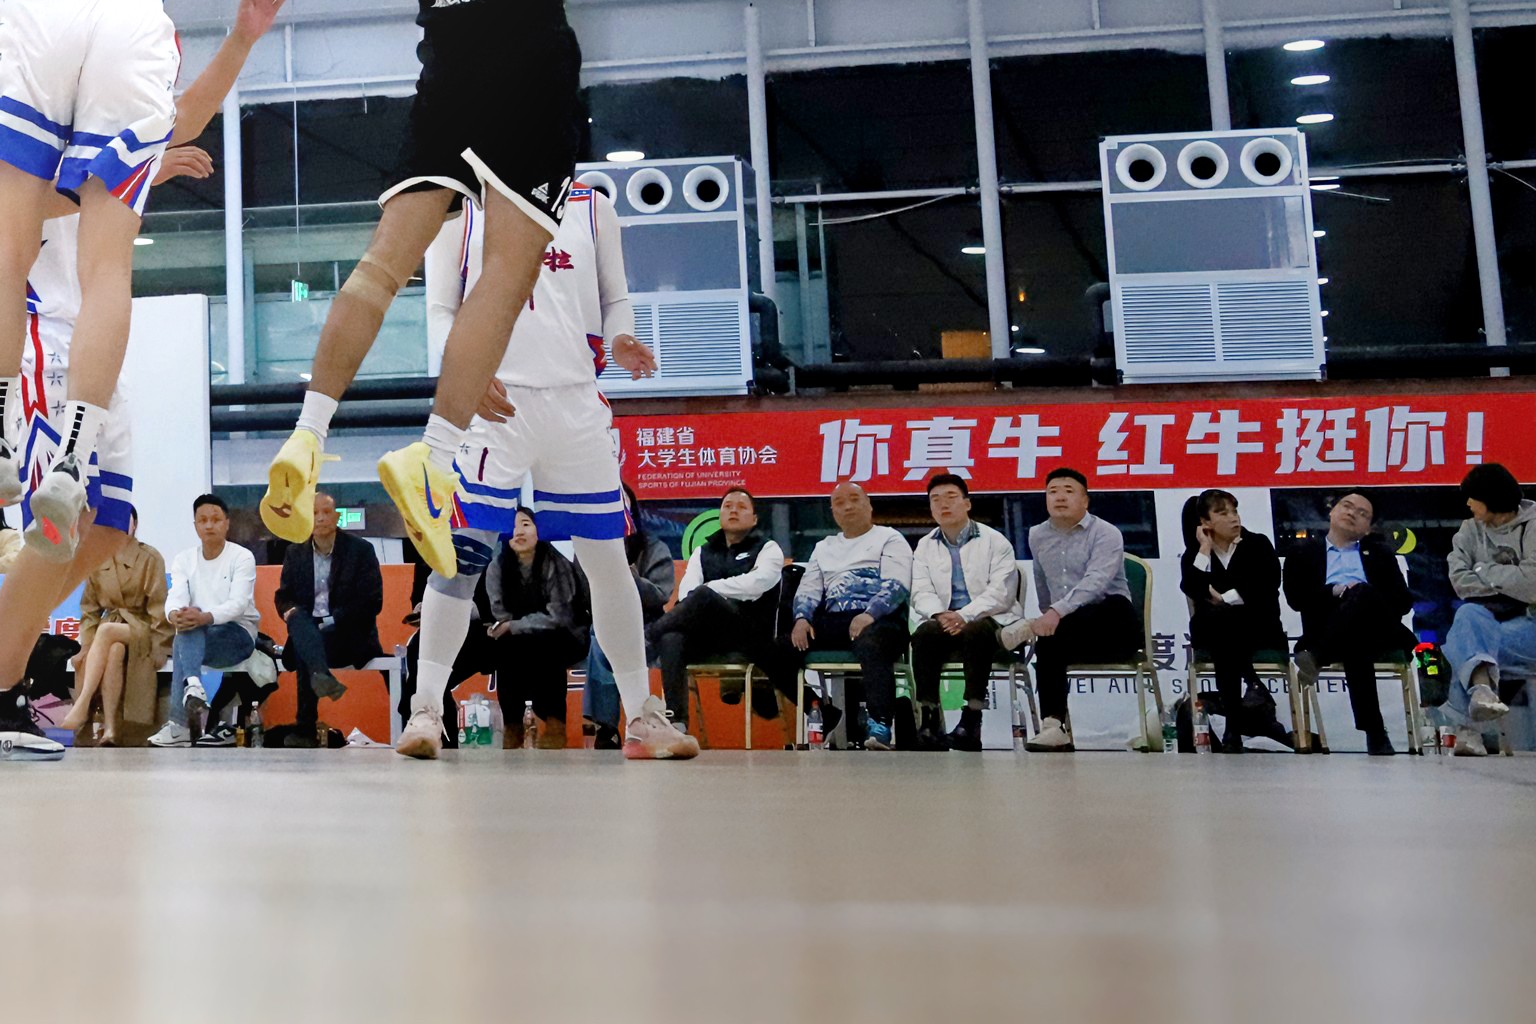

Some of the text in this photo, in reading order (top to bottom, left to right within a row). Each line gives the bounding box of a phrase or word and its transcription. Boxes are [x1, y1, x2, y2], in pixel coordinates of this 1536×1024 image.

[636, 426, 695, 447] 福建省
[820, 405, 1484, 483] 你真牛 红牛挺你！
[637, 444, 778, 469] 大学生体育协会
[637, 472, 684, 481] FEDERATION
[697, 470, 742, 479] UNIVERSITY
[637, 481, 668, 489] SPORTS
[680, 480, 707, 488] FUJIAN
[708, 479, 746, 487] PROVINCE
